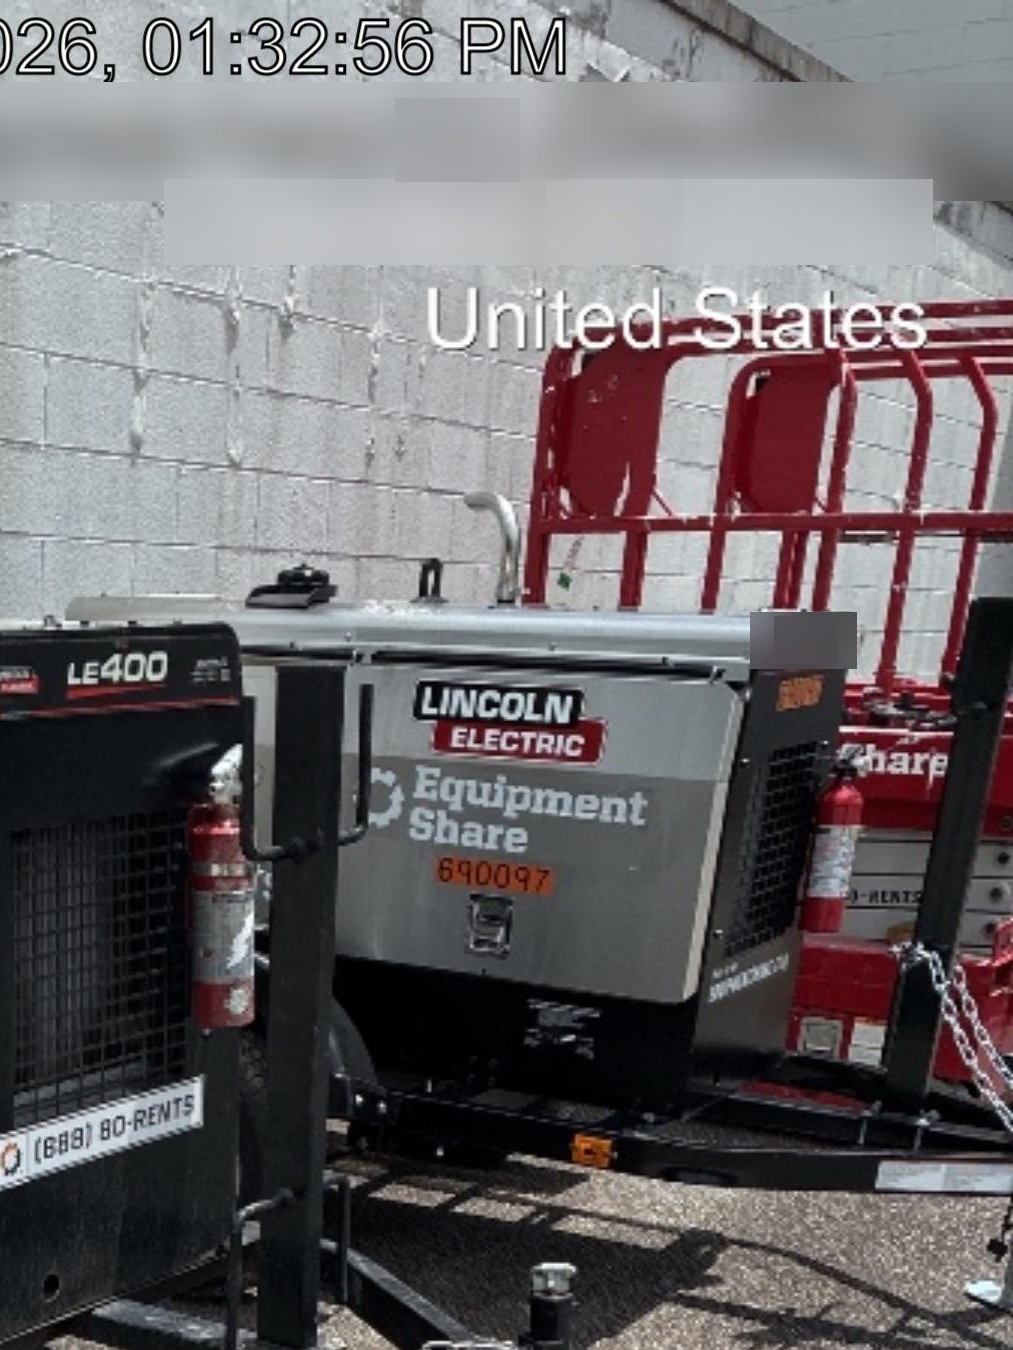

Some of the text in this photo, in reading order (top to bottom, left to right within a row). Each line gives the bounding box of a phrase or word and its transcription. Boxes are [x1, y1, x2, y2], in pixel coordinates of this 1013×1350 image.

[66, 651, 169, 685] LE400
[421, 686, 574, 724] LINCOLN
[450, 727, 586, 757] ELECTRIC
[413, 764, 649, 826] Equipment
[409, 806, 529, 853] Share
[437, 857, 551, 892] 690097
